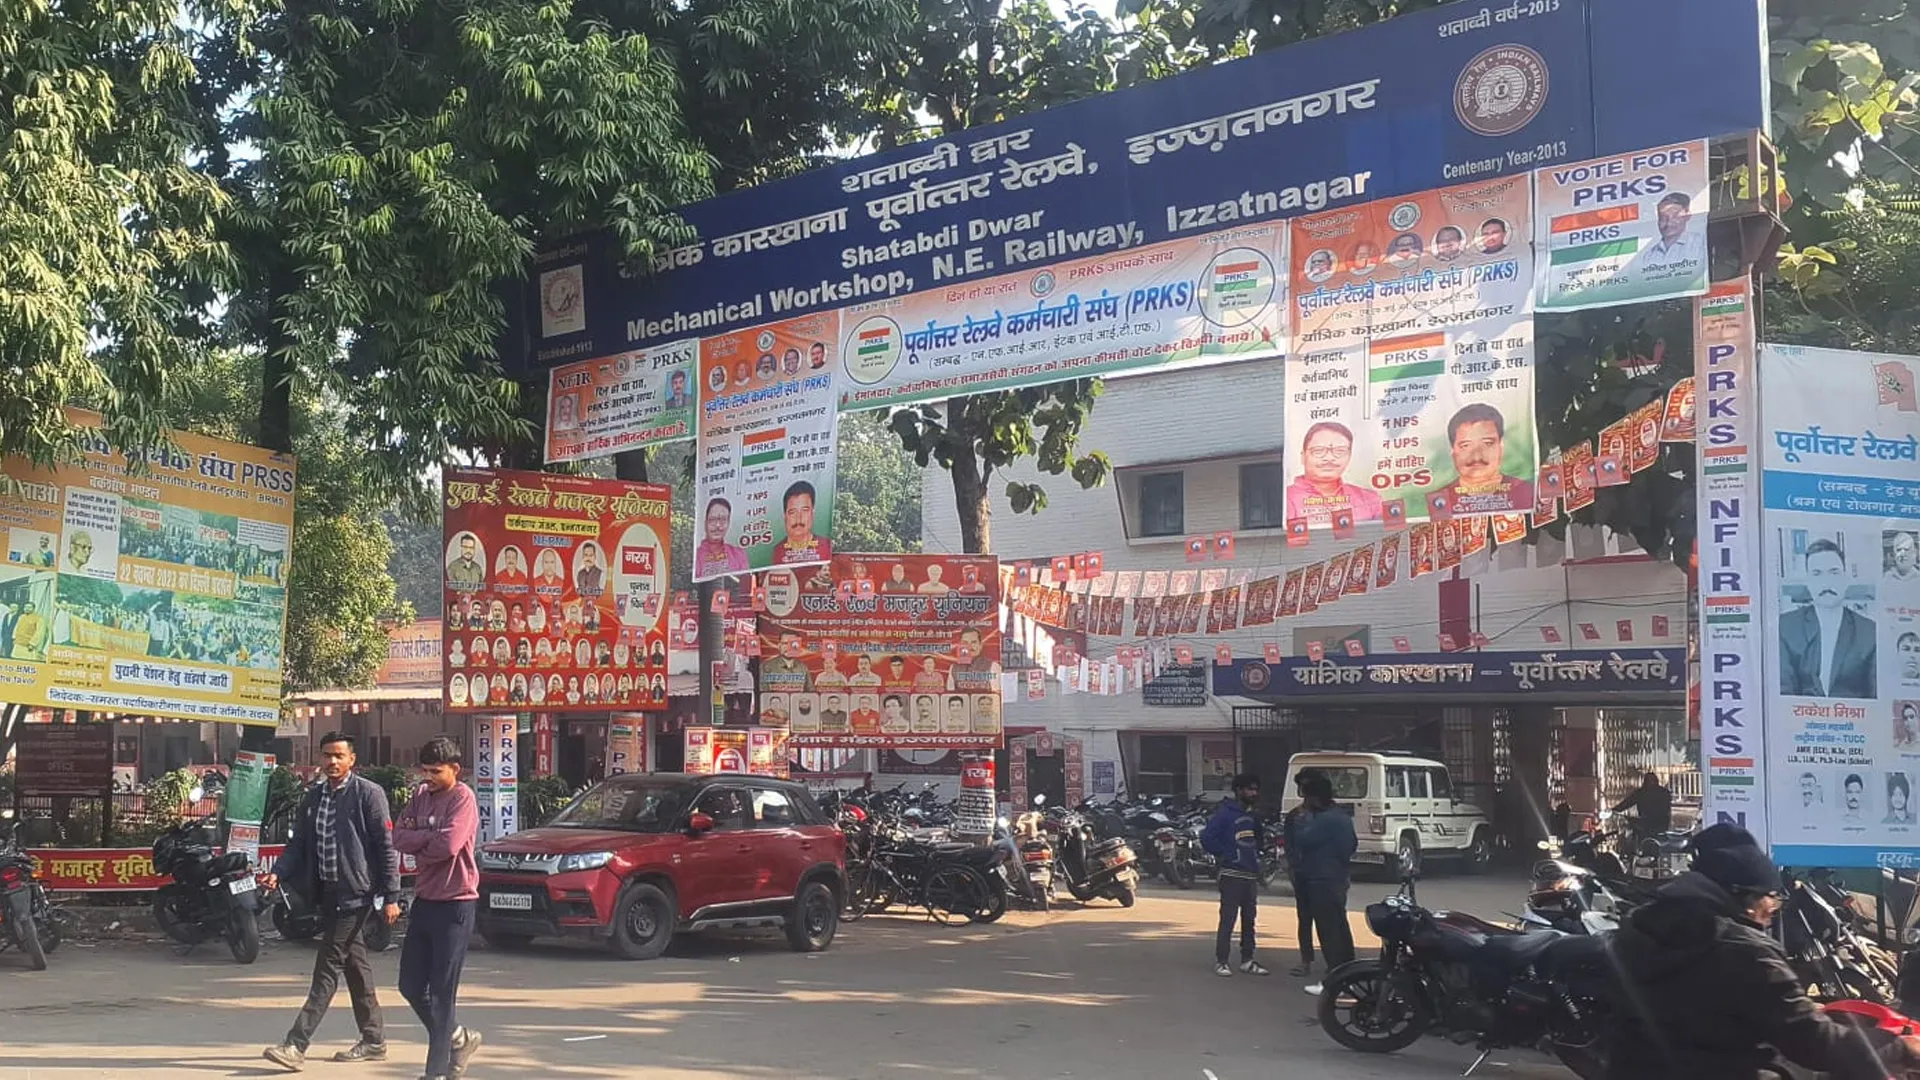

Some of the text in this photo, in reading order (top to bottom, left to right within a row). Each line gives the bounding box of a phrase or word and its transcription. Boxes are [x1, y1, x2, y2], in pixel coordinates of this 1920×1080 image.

[1438, 8, 1491, 37] शताब्दी
[1496, 50, 1543, 111] INDIAN RAILWAYS
[711, 78, 1381, 257] कारखाना पूर्वोत्तर रेलवे, इज्ज़तनगर
[841, 128, 1035, 194] शताब्दी द्वार
[1443, 140, 1567, 179] Centenary Year-2013
[1553, 148, 1689, 186] VOTE FOR
[1572, 174, 1668, 207] PRKS
[841, 208, 1045, 268] Shatabdi Dwar
[1568, 225, 1621, 245] PRKS
[626, 294, 762, 342] Mechanical
[769, 269, 915, 314] Workshop,
[932, 246, 994, 281] N.E.
[1004, 218, 1145, 265] Railway,
[1166, 170, 1372, 233] Izzatnagar
[1069, 250, 1175, 280] PRKS आपके साथ
[945, 281, 1018, 303] दिन हो या रात
[1297, 287, 1343, 318] पूर्वोत्तर
[1343, 281, 1376, 303] रेलवे
[1379, 268, 1437, 297] कर्मचारी
[1437, 267, 1464, 290] संघ
[1468, 259, 1519, 288] (PRKS)
[1600, 275, 1629, 287] PRKS
[903, 280, 1195, 365] पूर्वोत्तर रेलवे कर्मचारी संघ (PRKS)
[652, 347, 693, 370] PRKS
[1384, 349, 1429, 365] PRKS
[1454, 337, 1524, 356] दिन हो या रात
[1294, 384, 1358, 403] एवं समाजसेवी
[1461, 376, 1518, 394] आपके साथ
[1707, 344, 1738, 445] PRKS
[587, 401, 610, 414] PRKS
[1382, 416, 1419, 429] न NPS
[750, 441, 777, 453] PRKS
[1382, 438, 1419, 450] न UPS
[1775, 425, 1919, 463] पूर्वोत्तर रेलवे
[198, 452, 237, 482] संघ
[241, 460, 295, 494] PRSS
[1377, 454, 1425, 471] हमें चाहिए
[1371, 469, 1433, 490] OPS
[553, 490, 607, 518] मजदूर
[610, 490, 670, 521] यूनियन
[1846, 497, 1895, 513] रोजगार
[739, 531, 773, 548] OPS
[1709, 497, 1742, 593] NFIR
[624, 551, 652, 573] नरमू
[884, 589, 992, 618] मजदूर यूनियन
[114, 663, 140, 680] पुरानी
[1367, 662, 1474, 685] कारखाना
[1509, 651, 1603, 690] पूर्वोत्तर
[1607, 650, 1679, 685] रेलवे,
[1711, 653, 1744, 755] PRKS
[1792, 701, 1866, 719] राकेश मिश्रा
[479, 723, 491, 778] PRKS
[501, 723, 513, 777] PRKS
[1842, 734, 1866, 744] TUCC
[51, 859, 107, 885] मजदूर
